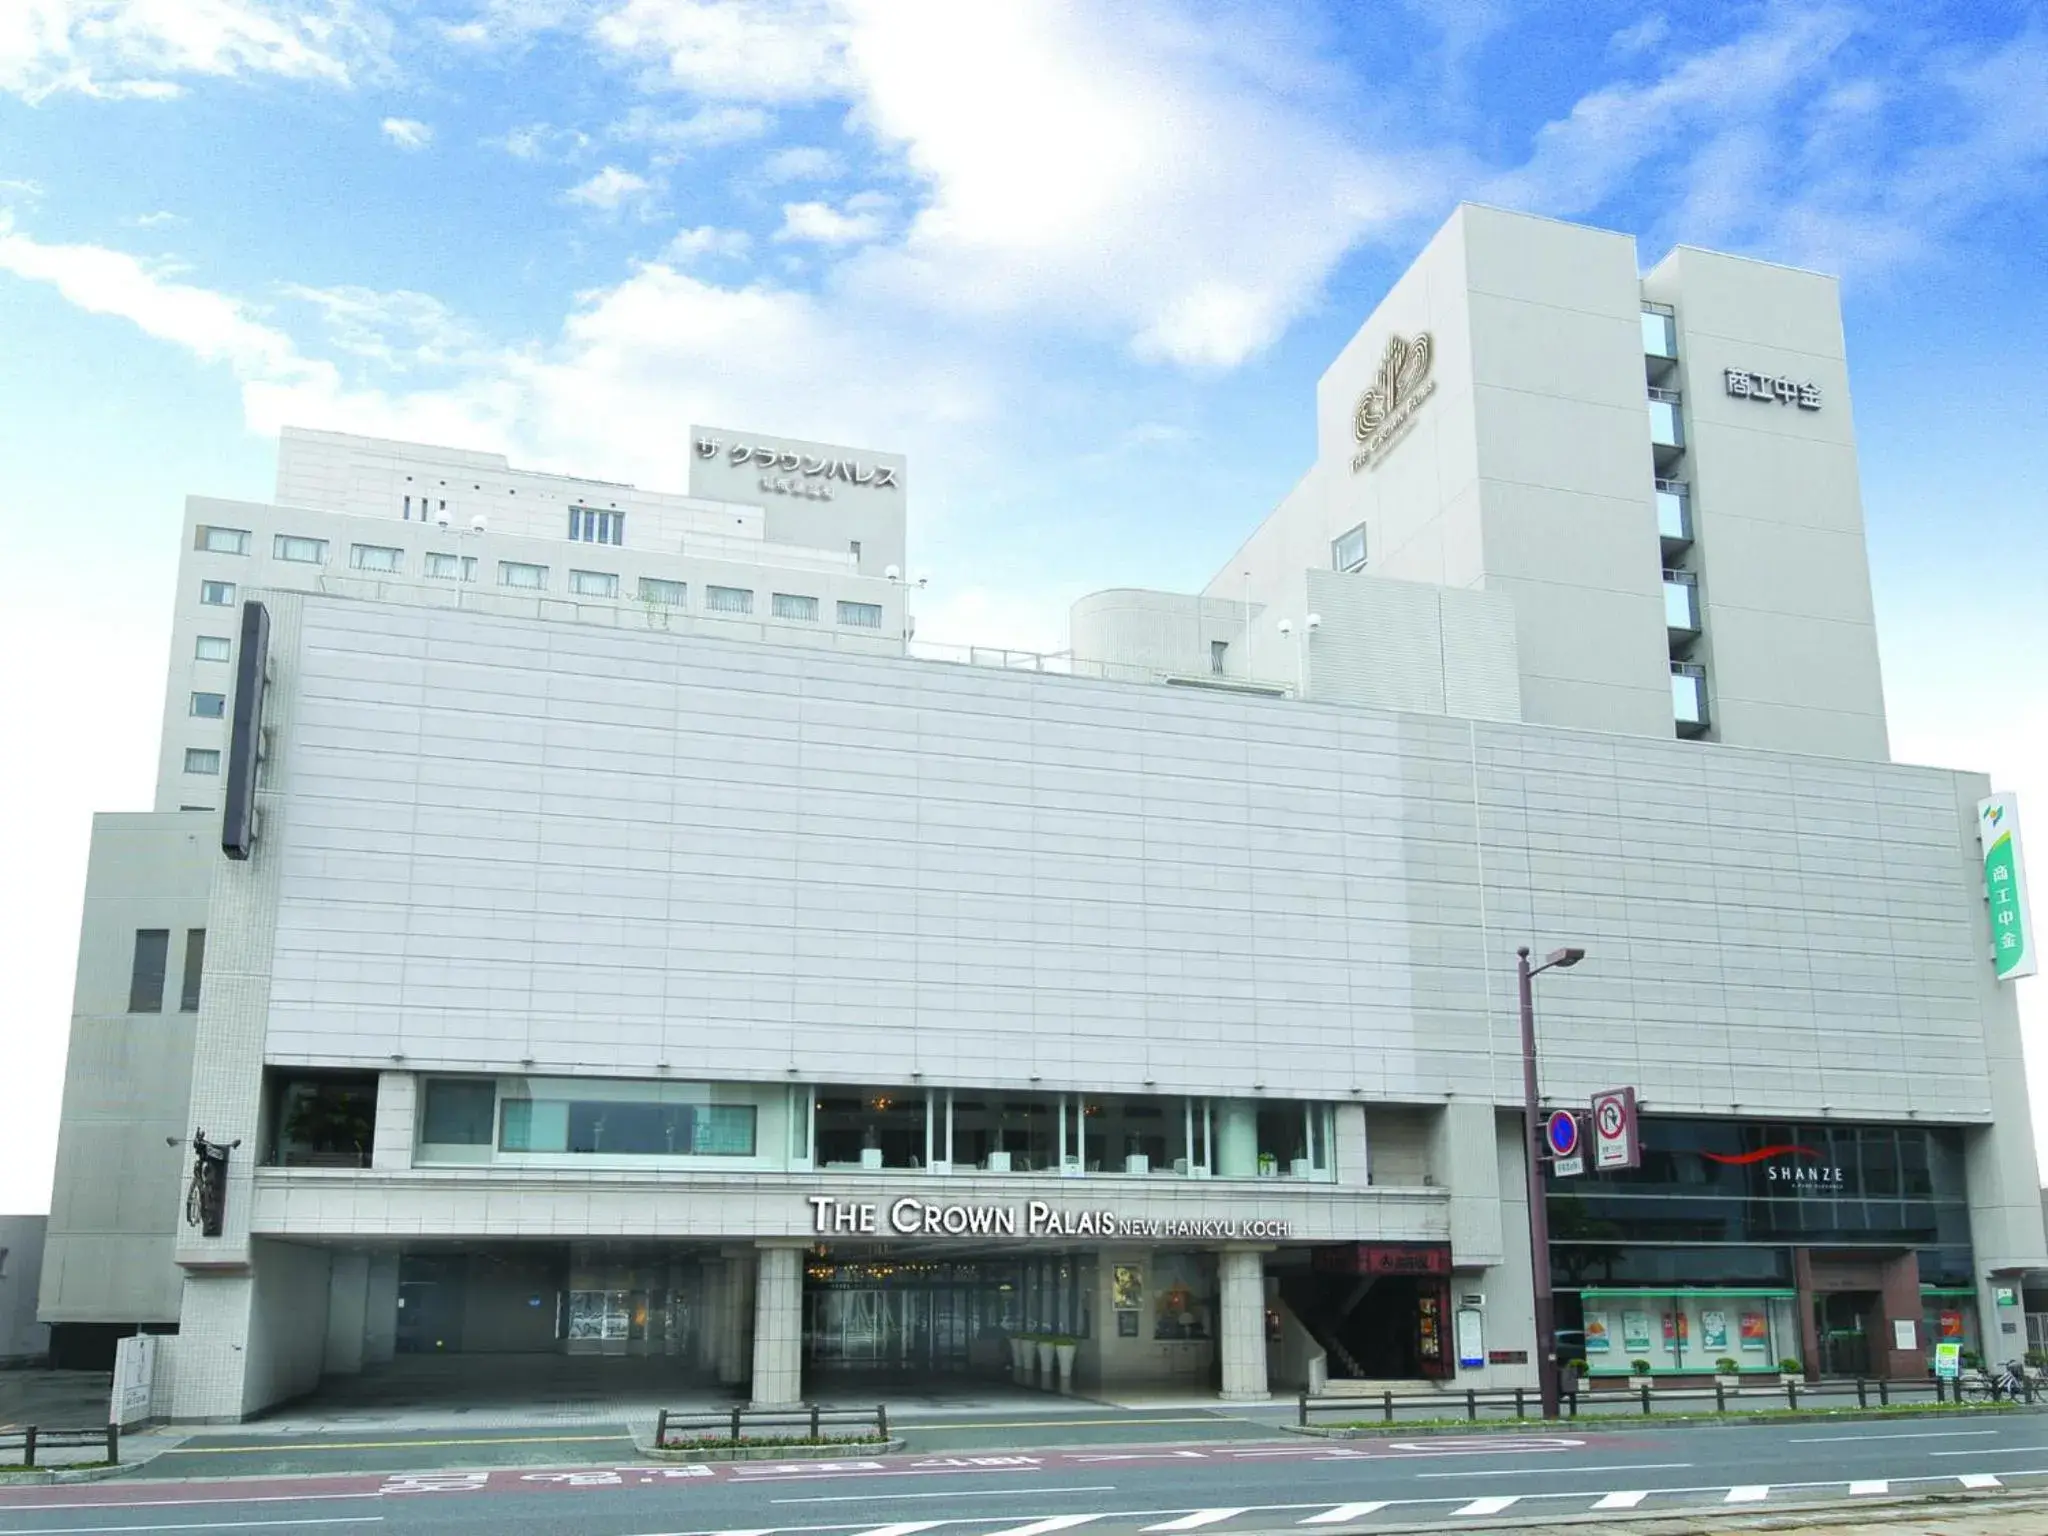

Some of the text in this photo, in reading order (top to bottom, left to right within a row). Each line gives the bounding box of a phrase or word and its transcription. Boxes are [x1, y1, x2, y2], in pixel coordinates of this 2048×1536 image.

[1725, 367, 1823, 411] 商工中金
[698, 437, 899, 490] ザ クラウンパレス
[1992, 865, 2017, 949] 商工中金
[1768, 1166, 1843, 1181] SHANZE
[809, 1197, 1292, 1236] THE CROWN PALAIS NEW HANKYU KOCHI
